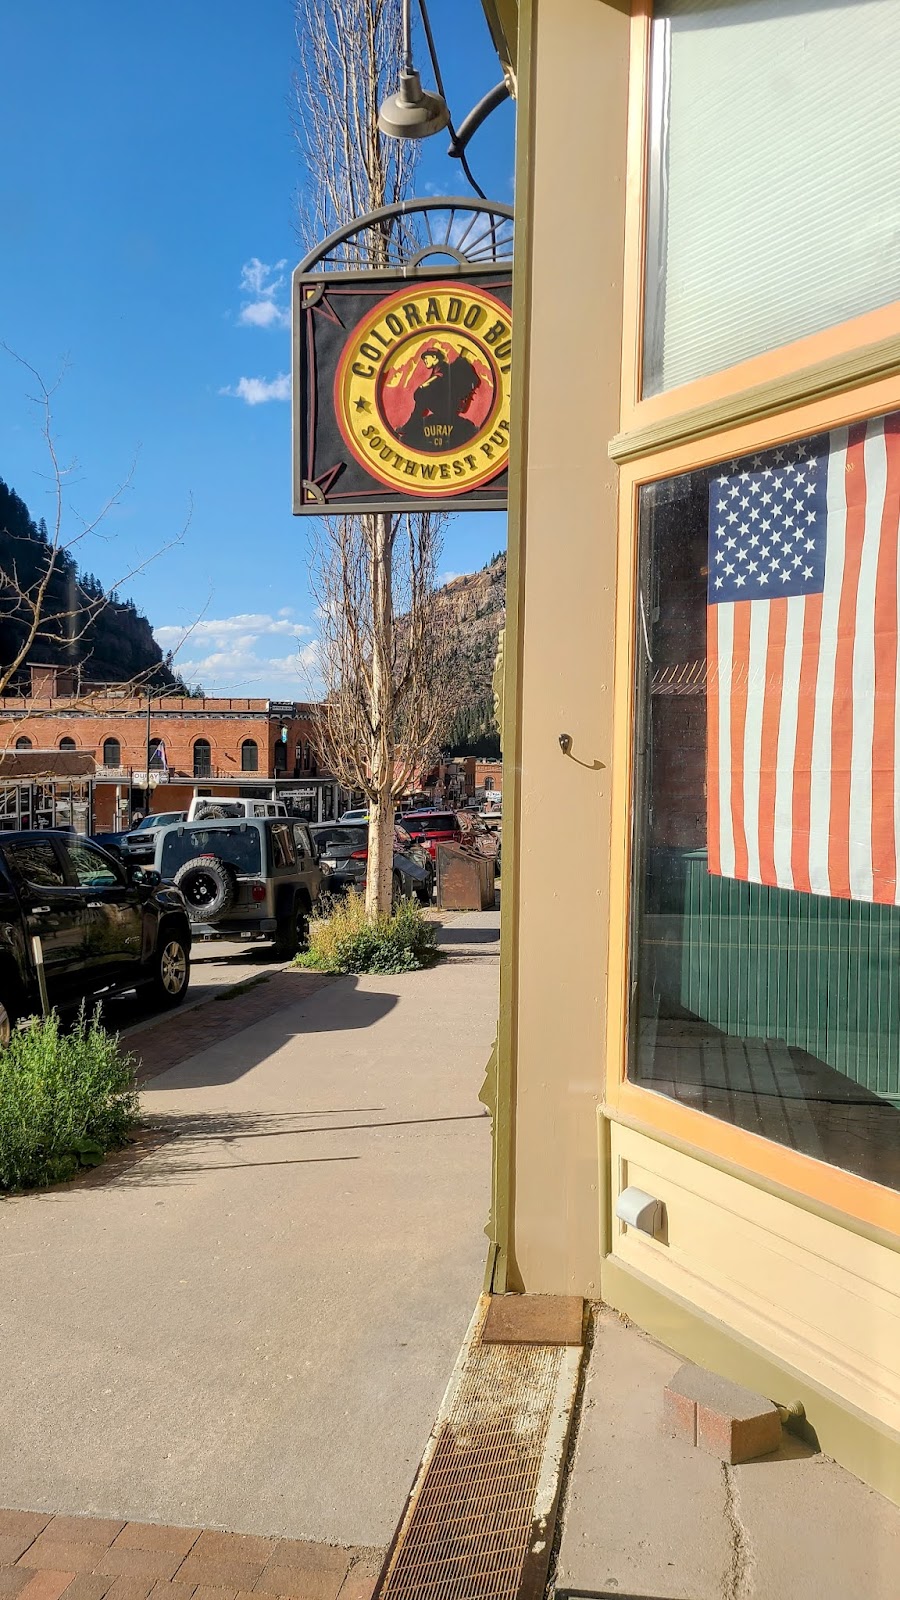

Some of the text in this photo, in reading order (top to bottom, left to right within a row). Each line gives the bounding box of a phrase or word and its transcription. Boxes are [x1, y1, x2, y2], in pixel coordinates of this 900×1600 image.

[351, 296, 482, 378] COLORADO
[423, 424, 454, 437] OURAY
[434, 438, 443, 446] CO
[361, 424, 475, 479] SOUTHWEST
